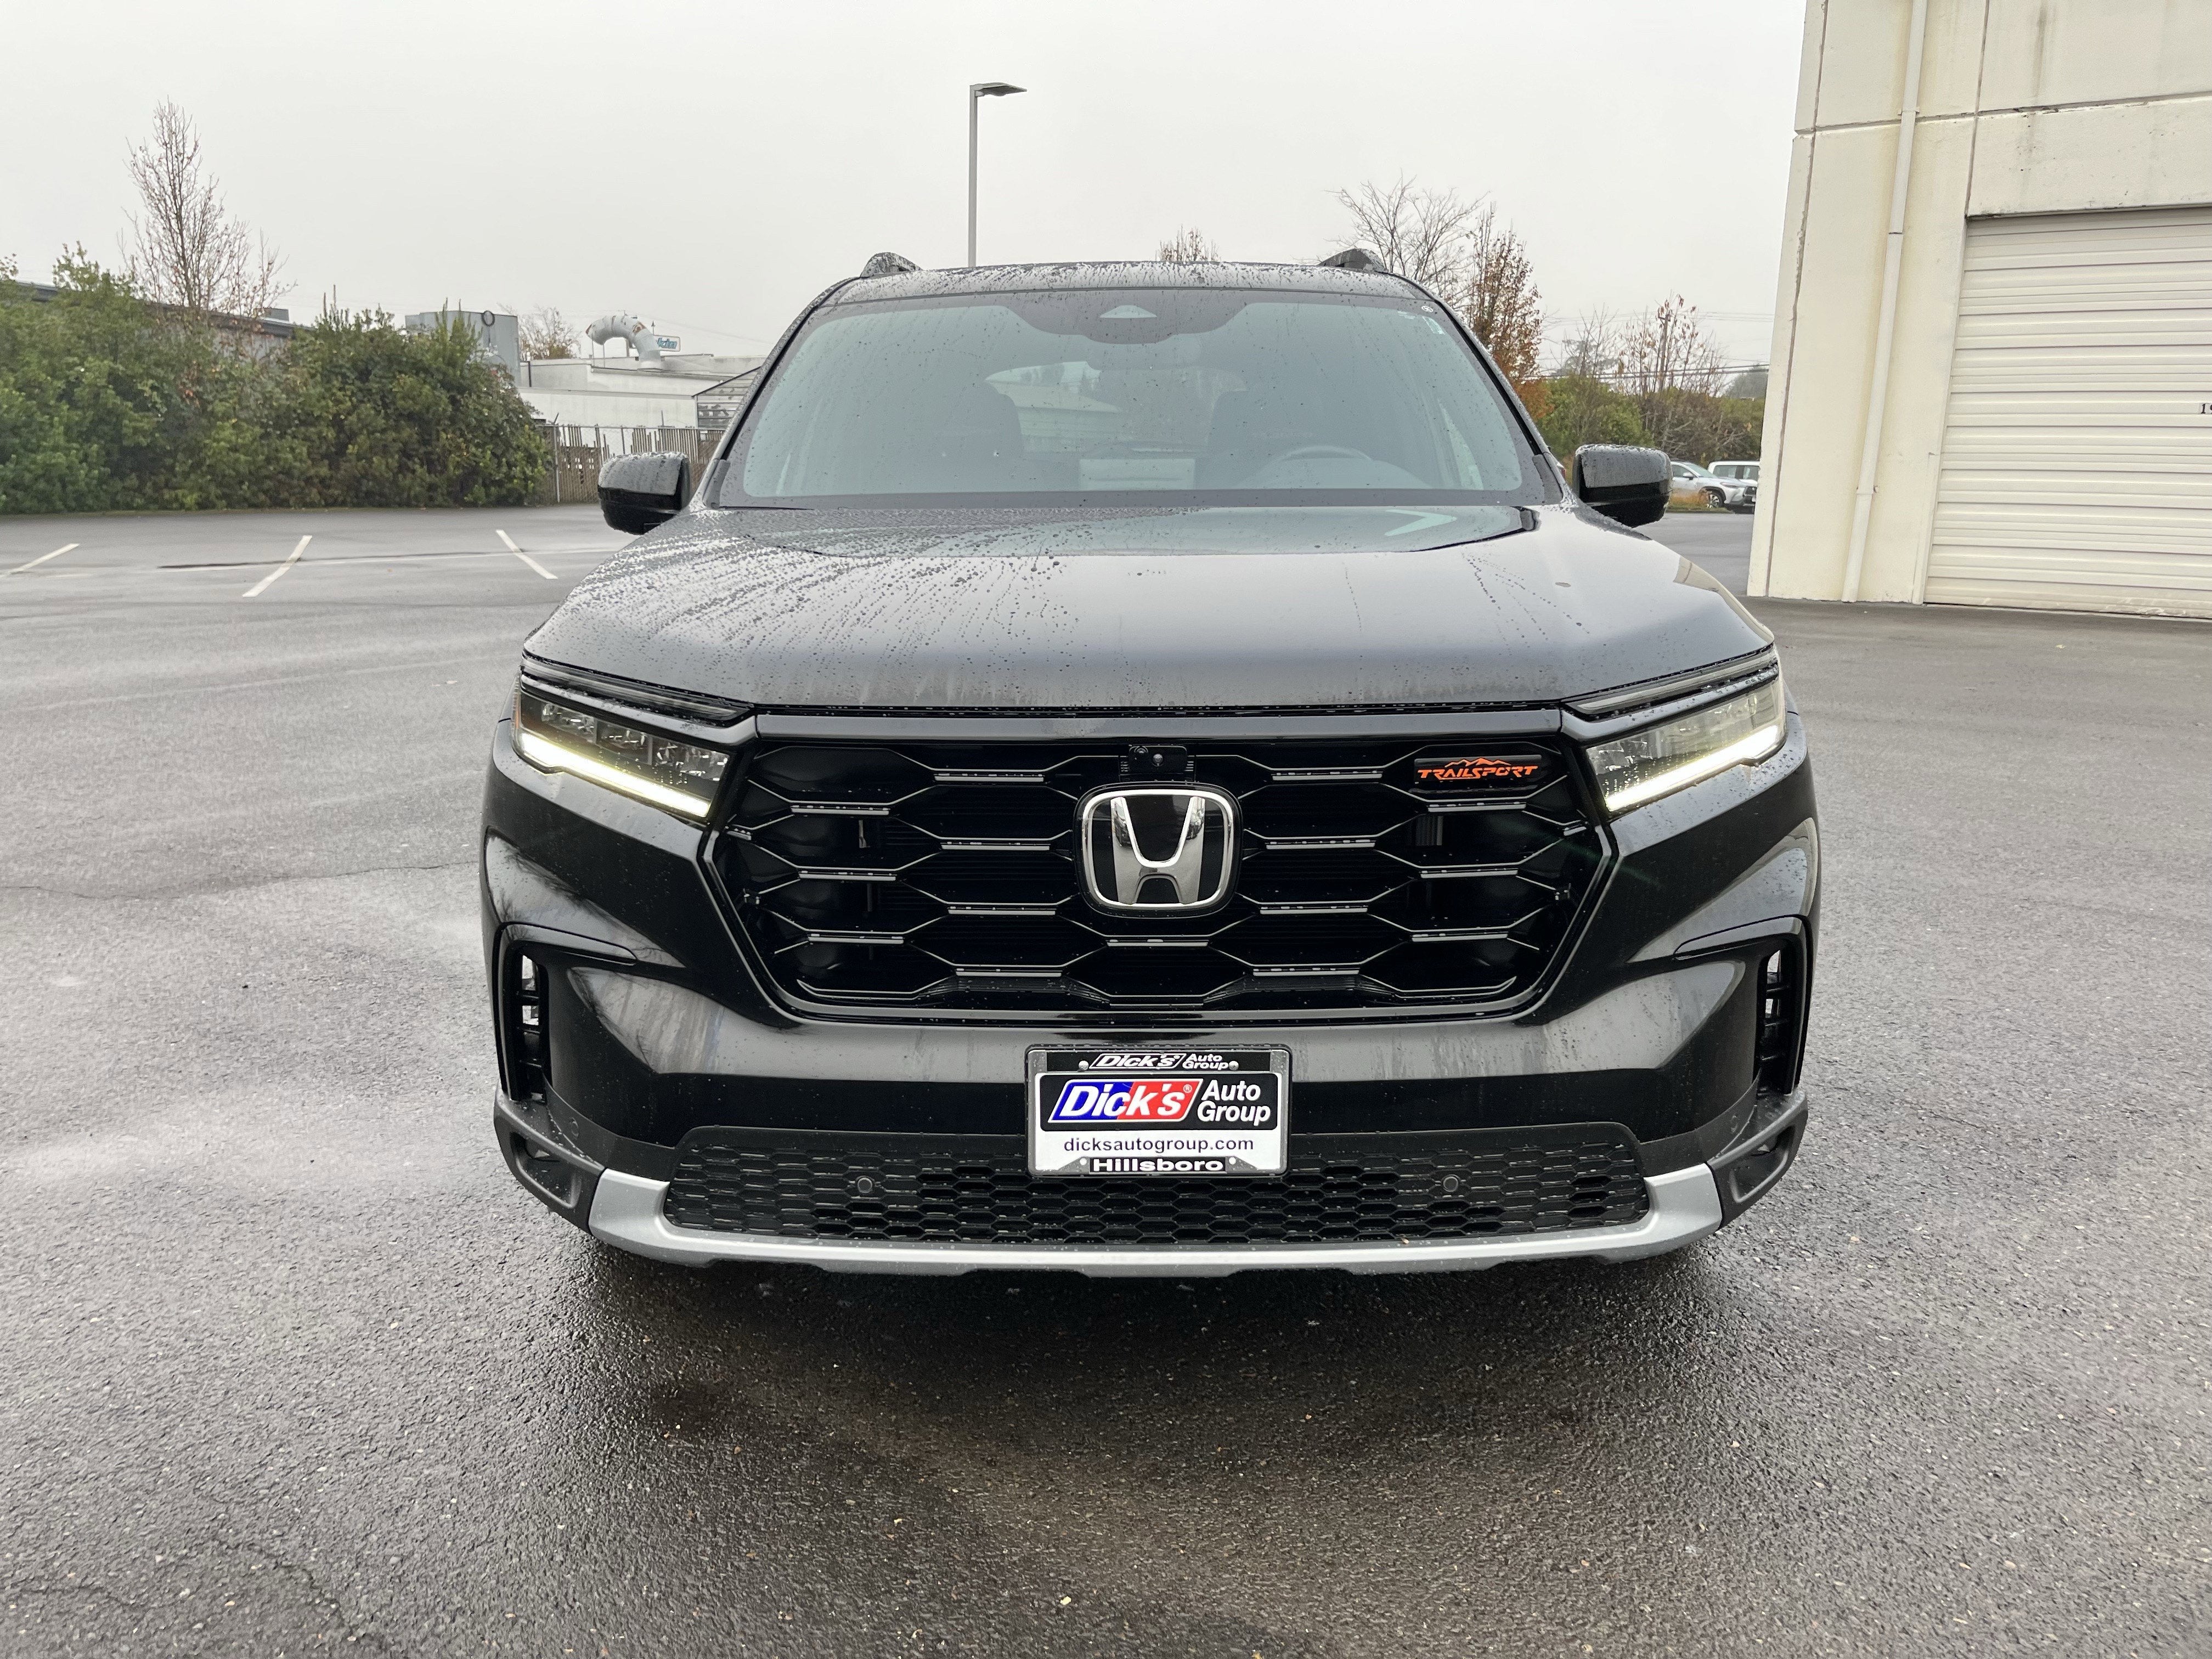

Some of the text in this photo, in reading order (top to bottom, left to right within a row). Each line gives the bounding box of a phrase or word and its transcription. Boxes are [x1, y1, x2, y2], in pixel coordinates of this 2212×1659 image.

[1417, 766, 1538, 780] TRAILSPORT
[1186, 1053, 1223, 1062] Auto
[1182, 1060, 1229, 1070] Group
[1201, 1079, 1261, 1102] Auto
[1197, 1100, 1271, 1126] Group
[1064, 1137, 1254, 1153] dicksautogroup.com
[1092, 1158, 1224, 1172] Hillsboro
